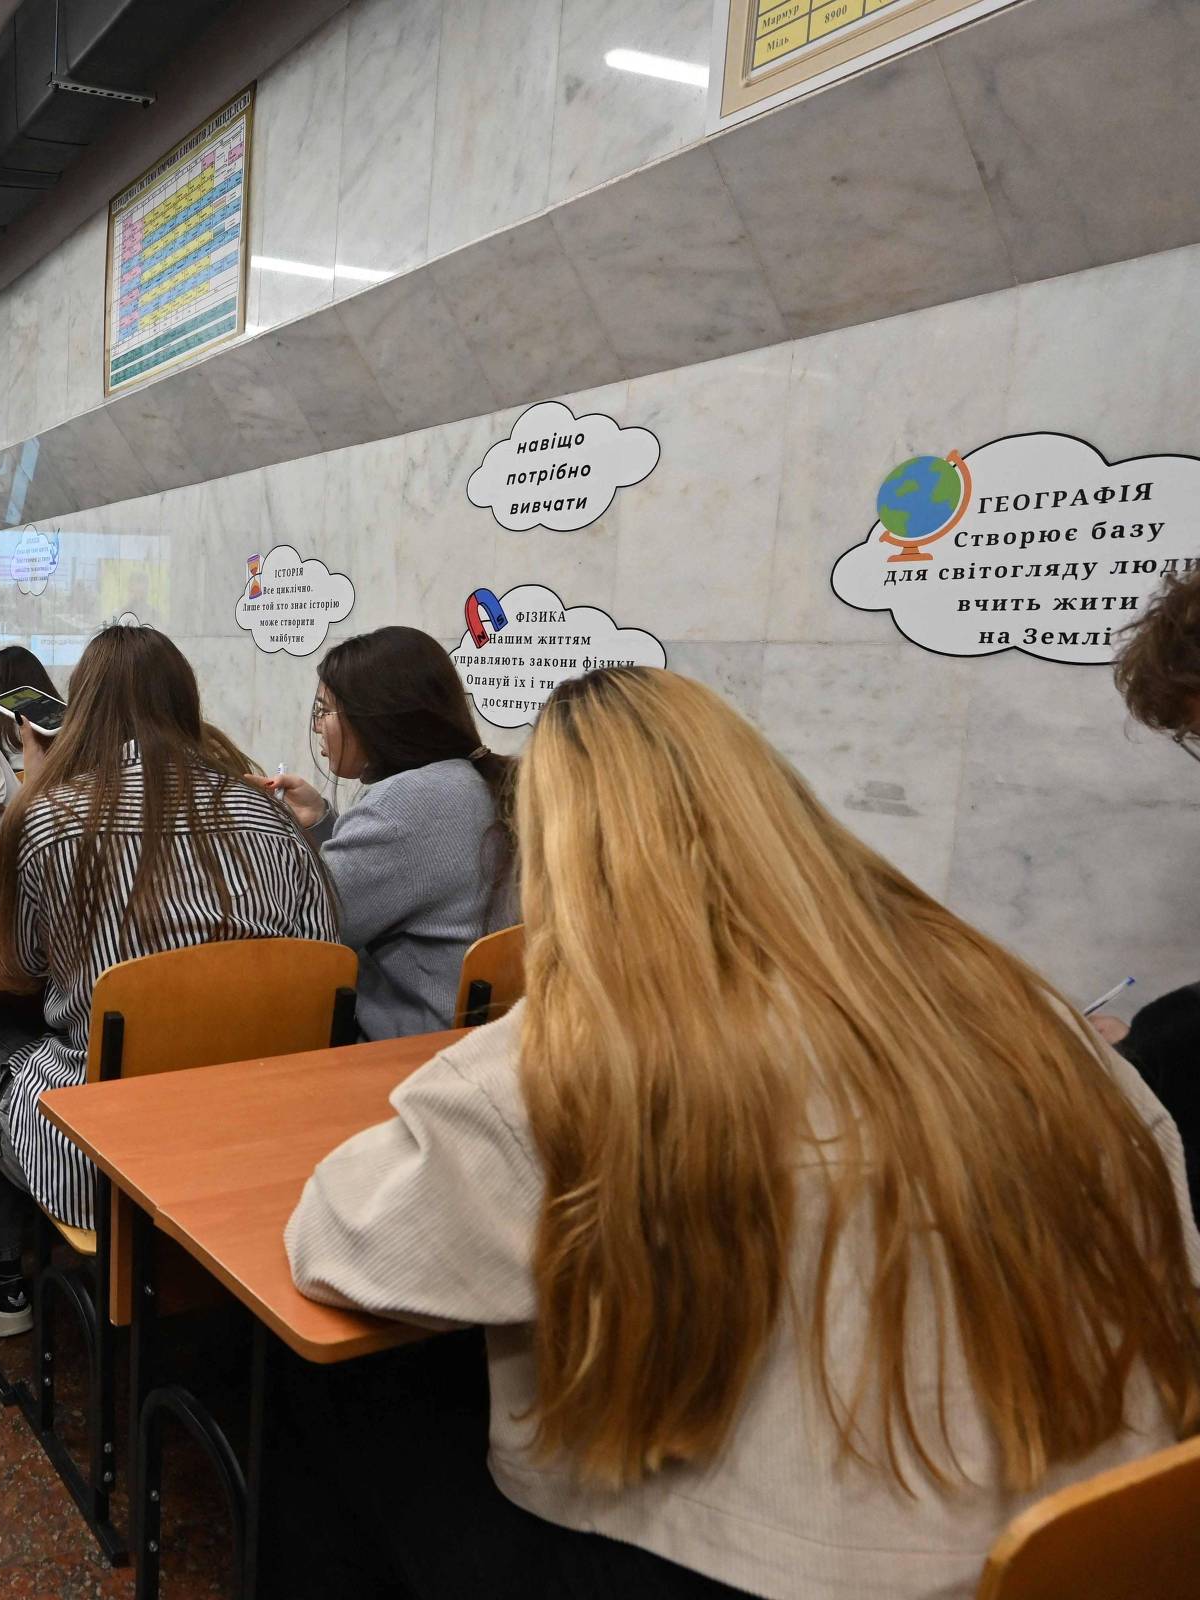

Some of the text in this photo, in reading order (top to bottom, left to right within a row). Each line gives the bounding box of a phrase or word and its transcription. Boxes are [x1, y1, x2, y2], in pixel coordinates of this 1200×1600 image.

[761, 5, 800, 30] Мармур
[824, 4, 848, 24] 8900
[767, 36, 789, 52] Міль
[517, 432, 585, 454] навіщо
[506, 463, 591, 486] потрібно
[510, 497, 587, 515] вивчати
[977, 482, 1154, 514] ГЕОГРАФІЯ
[954, 521, 1165, 549] Створює базу
[275, 567, 304, 579] ІСТОРІЯ
[884, 568, 929, 586] для
[938, 561, 1098, 581] світогляду
[263, 586, 275, 595] Все
[243, 600, 340, 612] Лише той хто знає історію
[957, 595, 1139, 613] вчить жити
[260, 618, 315, 629] може створити
[516, 611, 566, 623] ФІЗИКА
[270, 633, 304, 644] майбутнє
[489, 633, 591, 646] Нашим життям
[978, 627, 1112, 647] на Землі
[454, 655, 525, 667] управляють
[529, 657, 577, 668] закони
[466, 674, 555, 689] Опануй їх і ти
